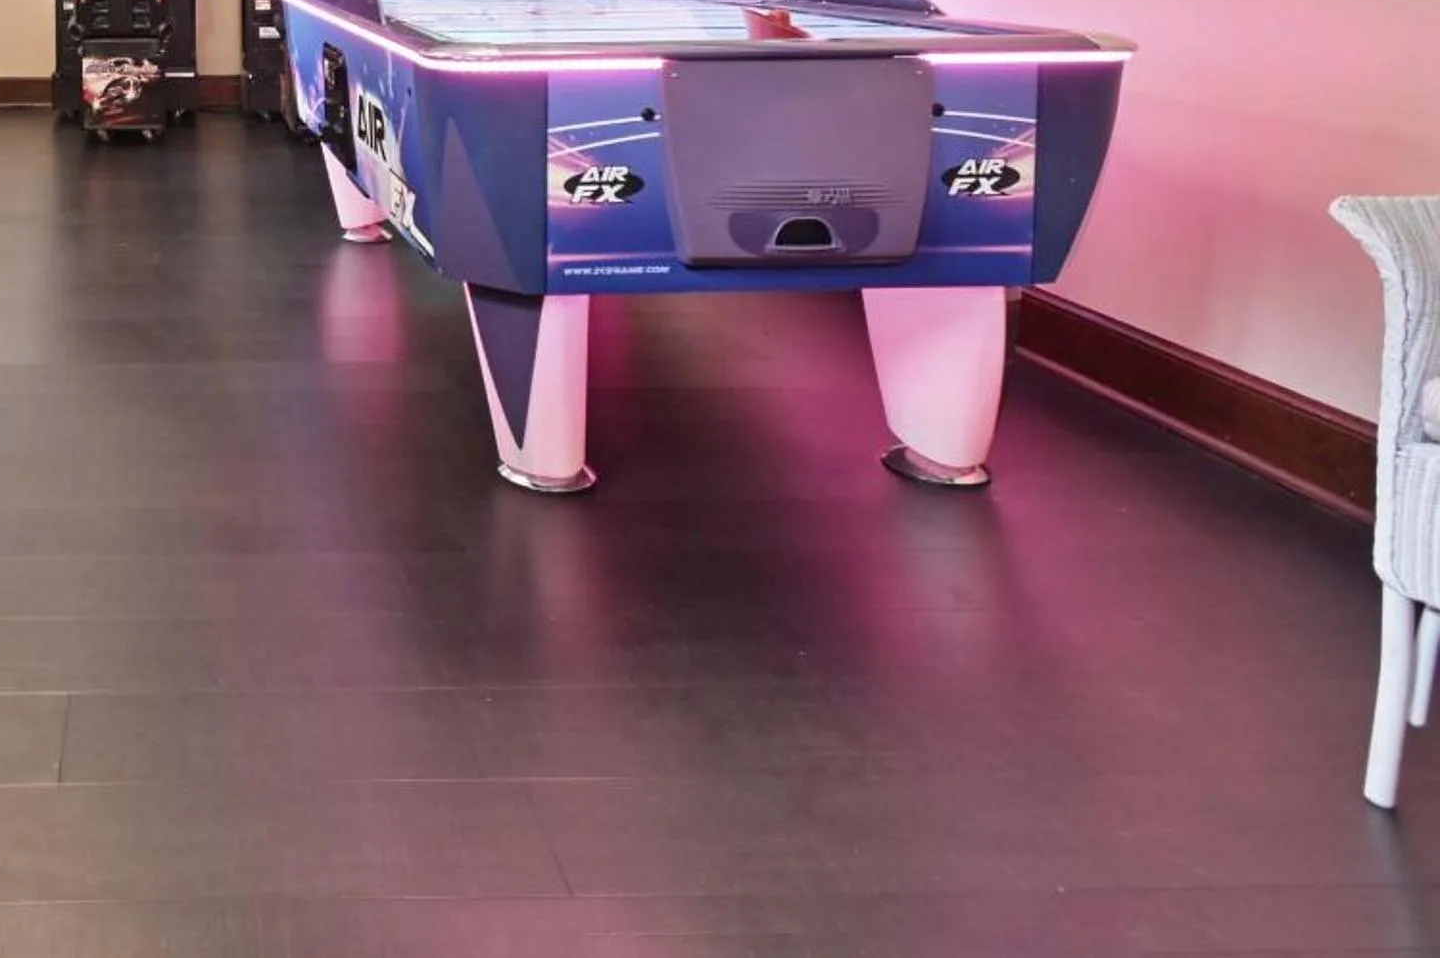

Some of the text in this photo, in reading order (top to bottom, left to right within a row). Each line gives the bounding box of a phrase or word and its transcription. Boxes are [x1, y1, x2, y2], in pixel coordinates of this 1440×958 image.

[358, 94, 387, 161] AIR
[581, 166, 629, 182] AIR
[958, 158, 1006, 175] AIR
[571, 184, 626, 203] FX
[947, 176, 1002, 197] FX
